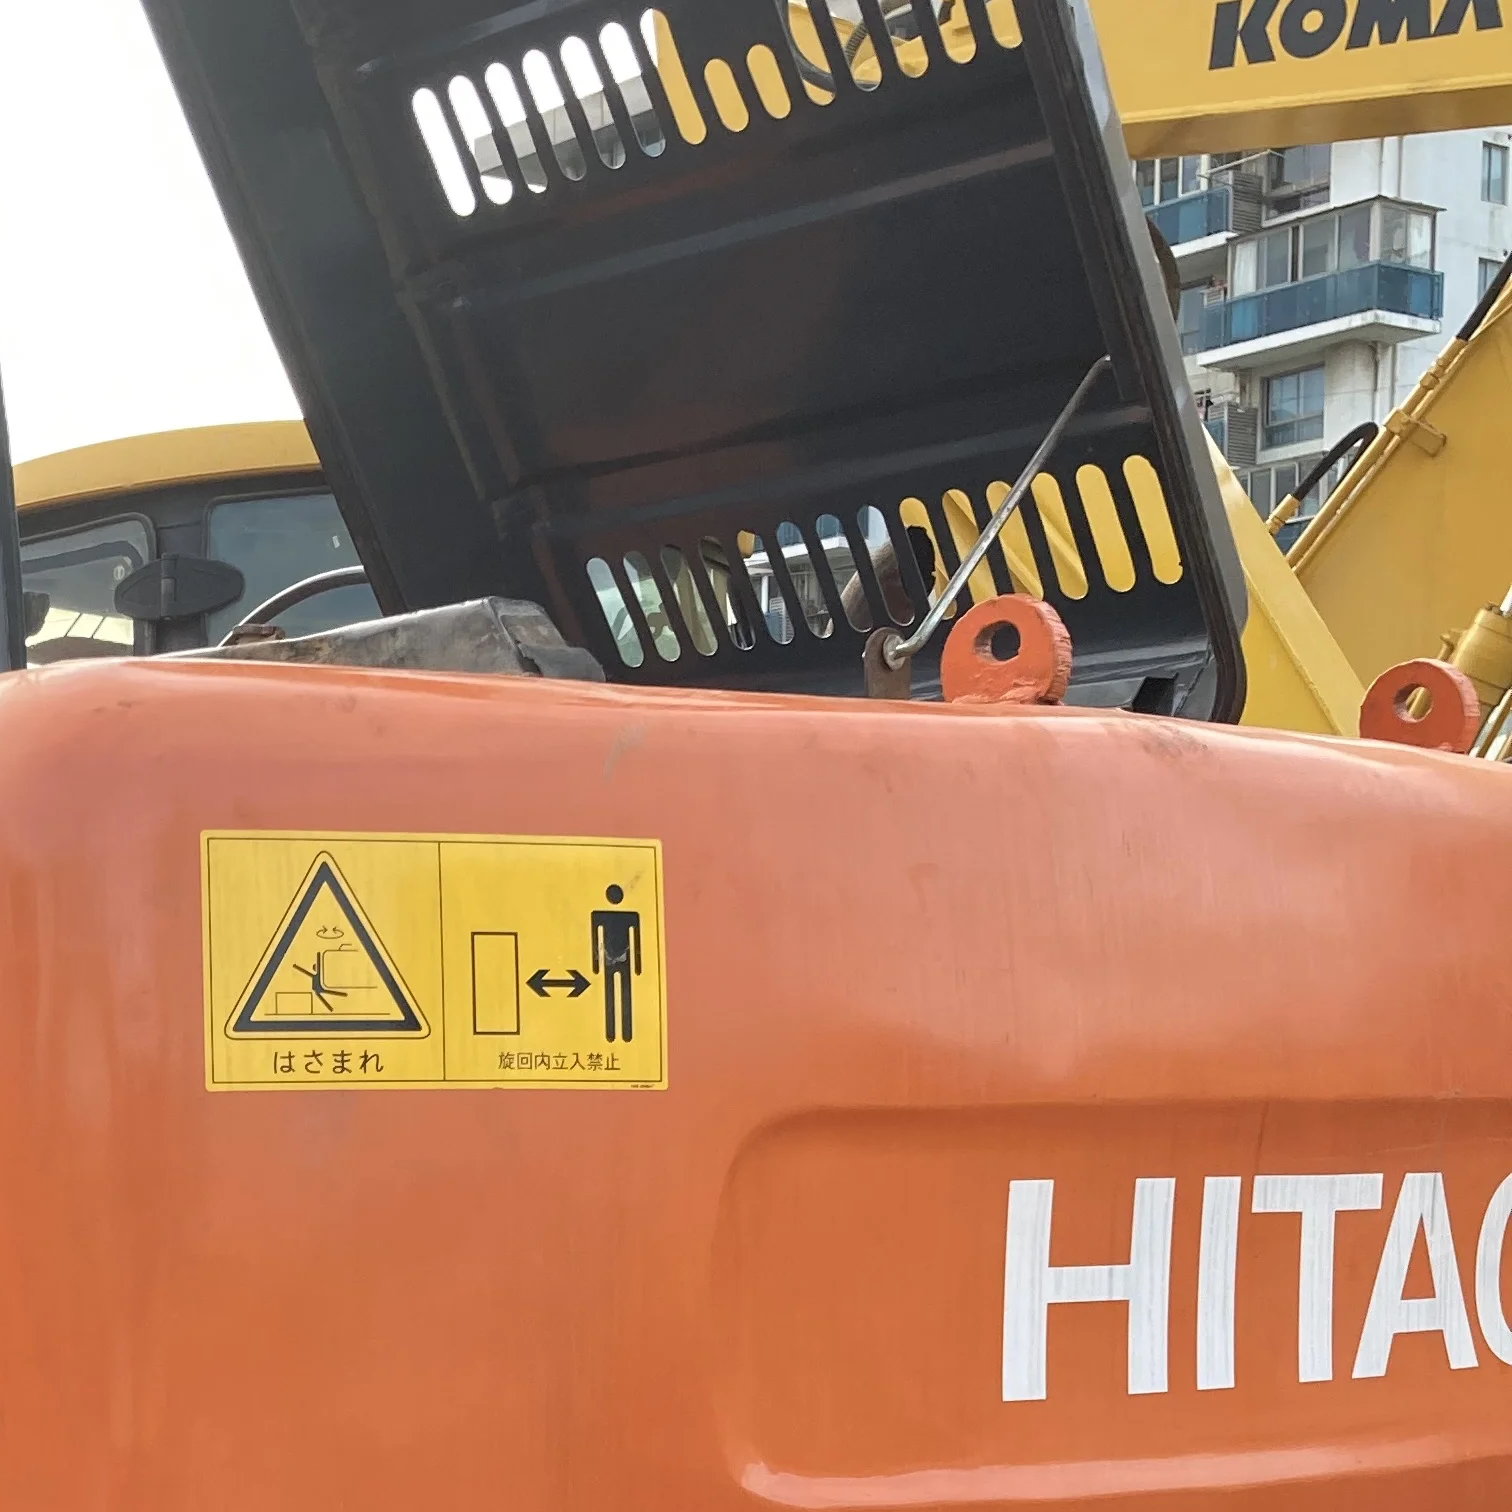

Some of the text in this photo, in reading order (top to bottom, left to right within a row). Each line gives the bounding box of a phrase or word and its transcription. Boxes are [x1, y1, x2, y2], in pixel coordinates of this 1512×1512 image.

[273, 1048, 384, 1075] はさまれ
[497, 1051, 622, 1072] 旋回内立入禁止
